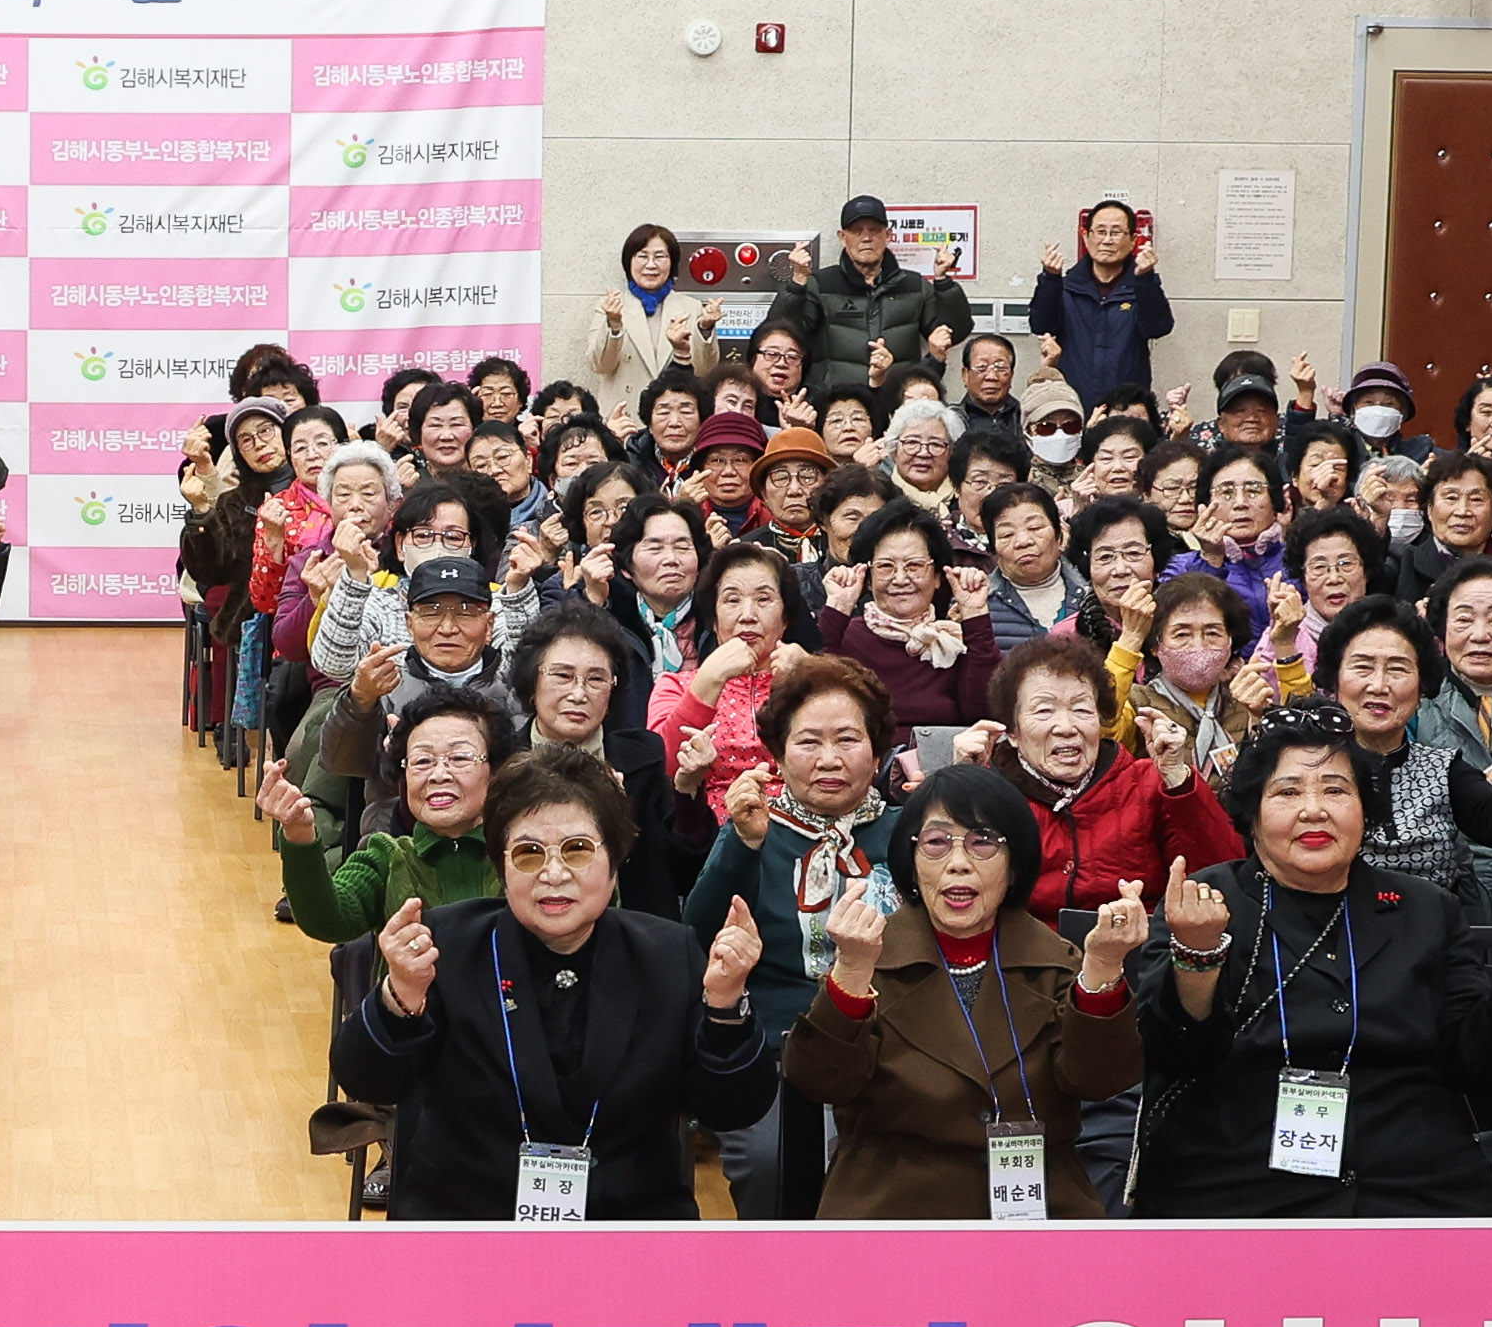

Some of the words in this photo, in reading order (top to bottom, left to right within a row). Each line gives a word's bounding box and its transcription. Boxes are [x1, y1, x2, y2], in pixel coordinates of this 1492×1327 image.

[119, 67, 247, 90] 김해시복지재단
[312, 58, 525, 87] 김해시동부노인종합복지관
[50, 138, 271, 163] 김해시동부노인종합복지관
[377, 139, 500, 166] 김해시복지재단
[117, 212, 244, 234] 김해시복지재단
[310, 204, 524, 232] 김해시동부노인종합복지관
[50, 283, 269, 308] 김해시동부노인종합복지관
[375, 285, 499, 311] 김해시복지재단
[117, 503, 186, 523] 김해시복
[50, 573, 180, 595] 김해시동부노인
[1278, 1129, 1338, 1152] 장순자
[522, 1158, 587, 1173] 동부실버아카데미
[999, 1154, 1035, 1169] 부회장
[993, 1183, 1042, 1203] 배순례
